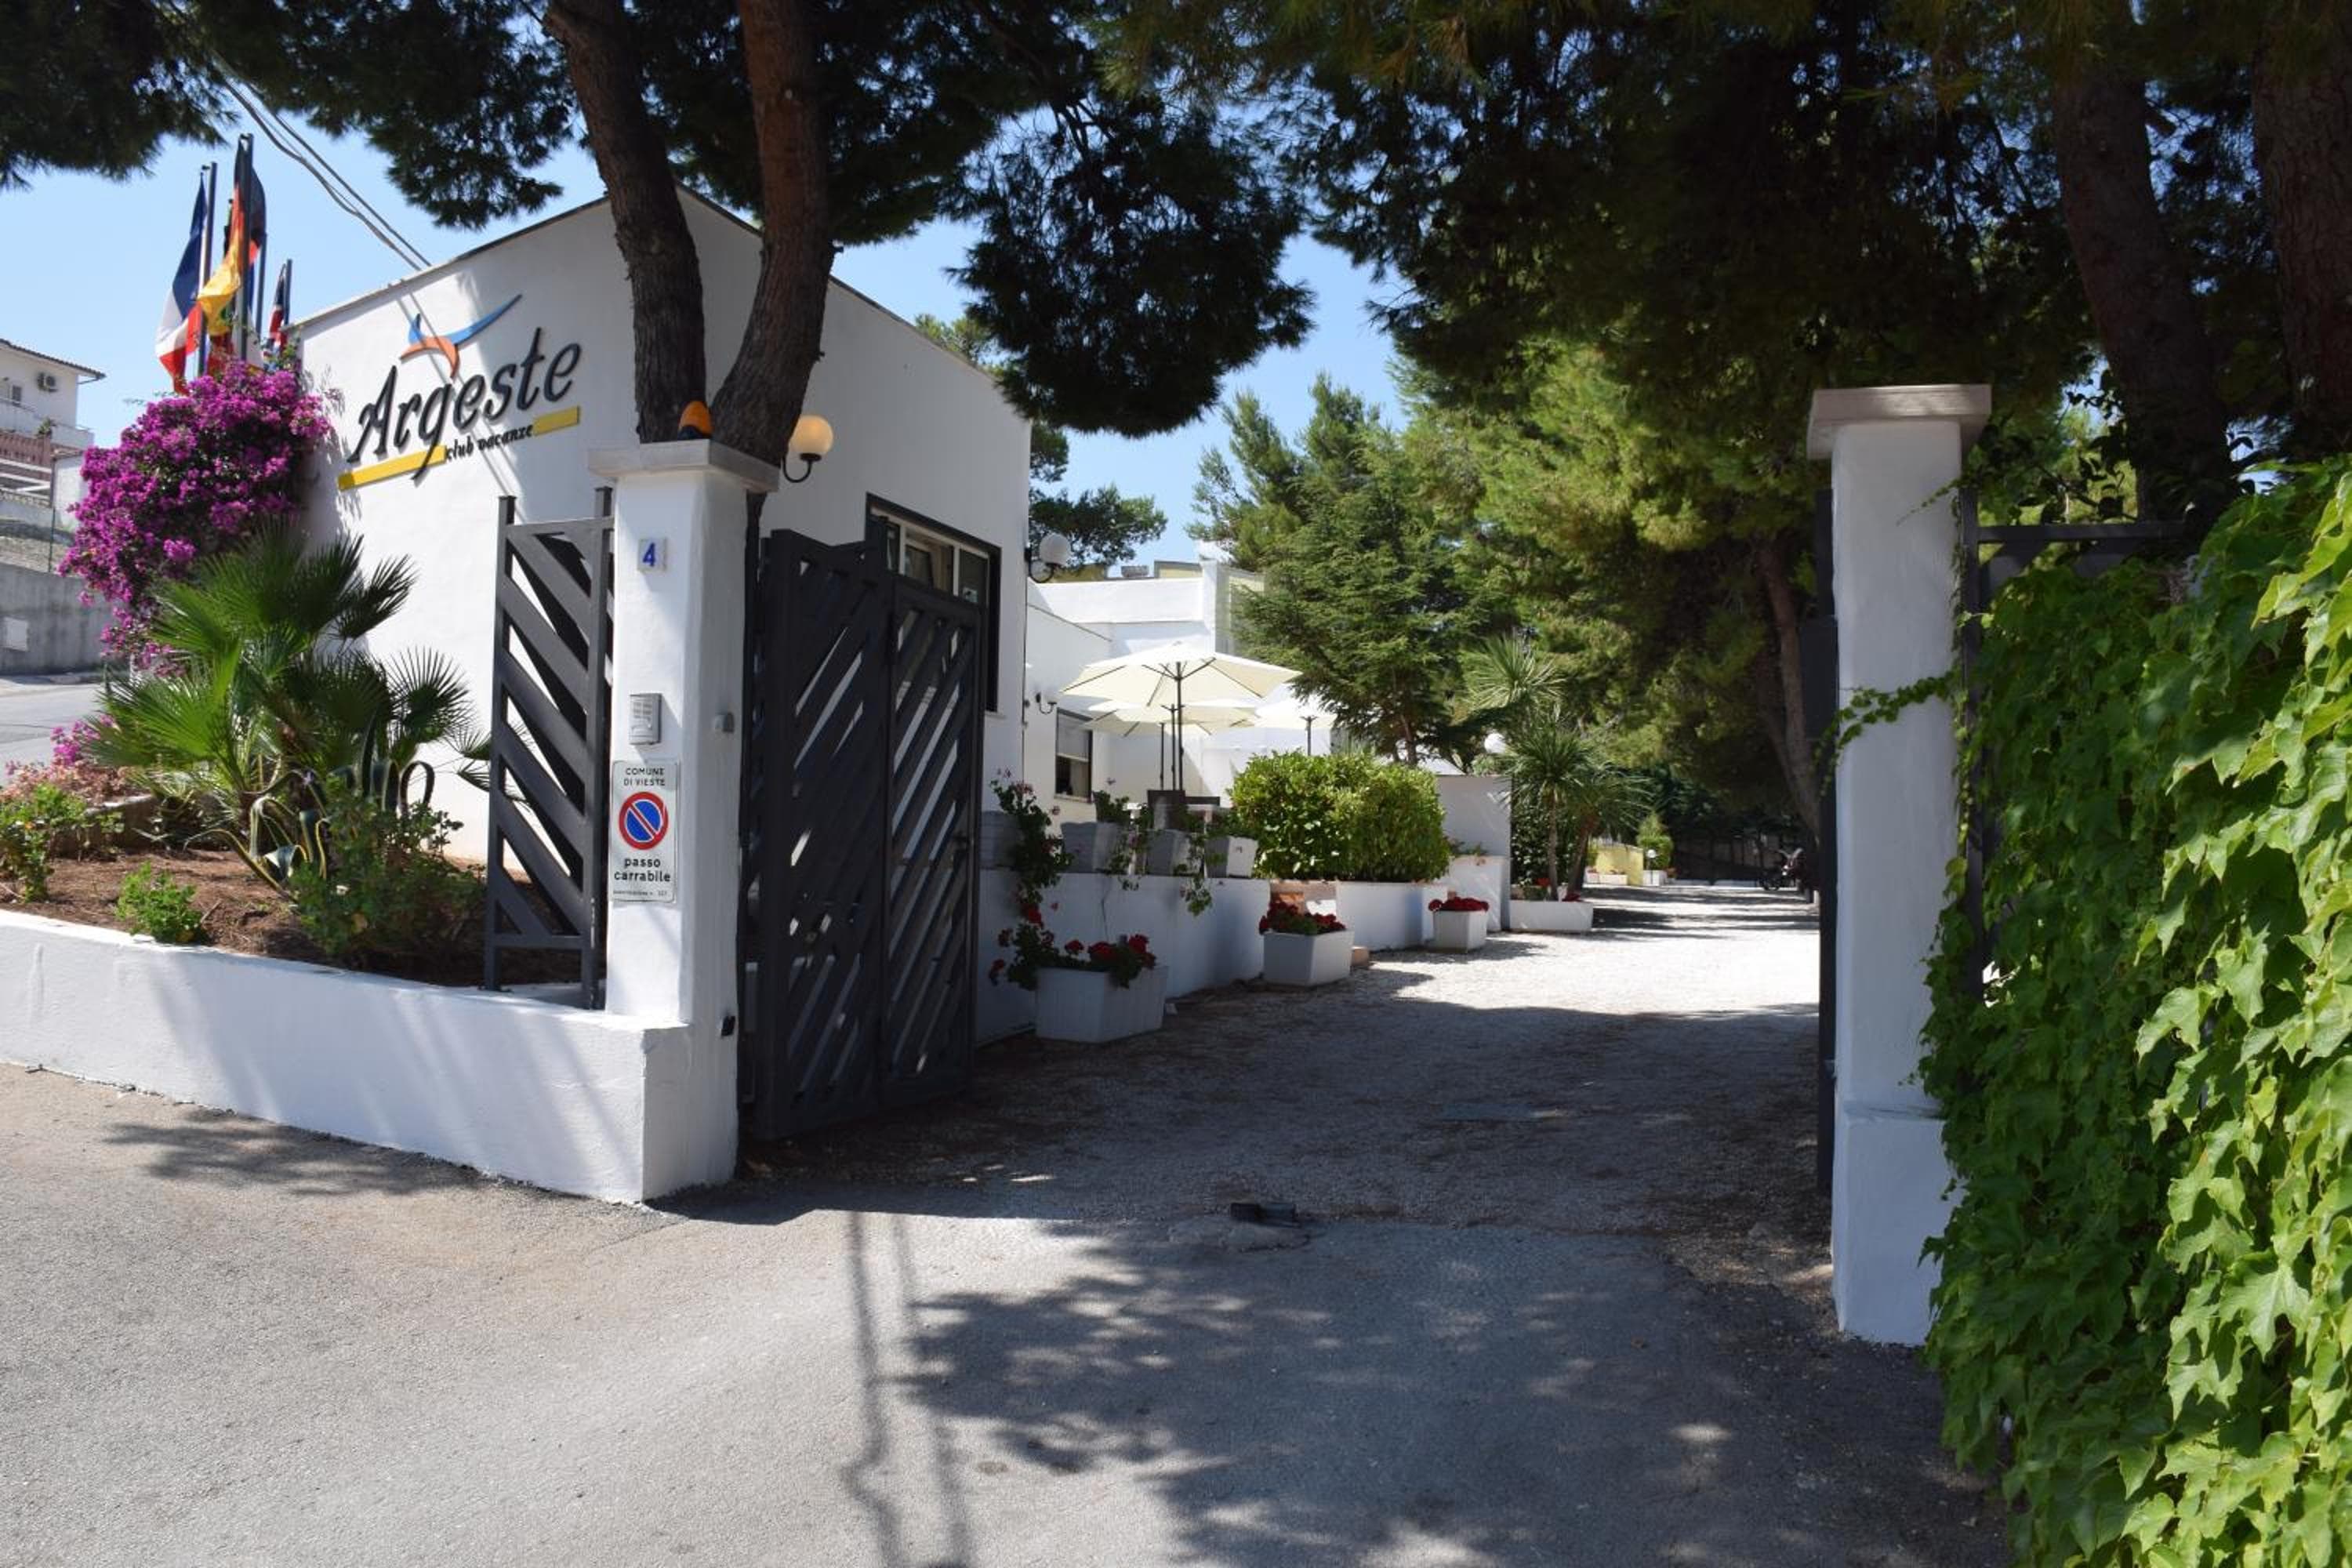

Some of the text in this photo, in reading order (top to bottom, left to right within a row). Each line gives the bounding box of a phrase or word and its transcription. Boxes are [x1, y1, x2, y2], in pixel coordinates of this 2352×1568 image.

[347, 327, 582, 481] Argeste
[446, 425, 533, 459] club vacanze
[642, 543, 655, 567] 4
[626, 767, 666, 775] COMUNE
[624, 858, 661, 869] passo
[614, 870, 671, 882] carrabile
